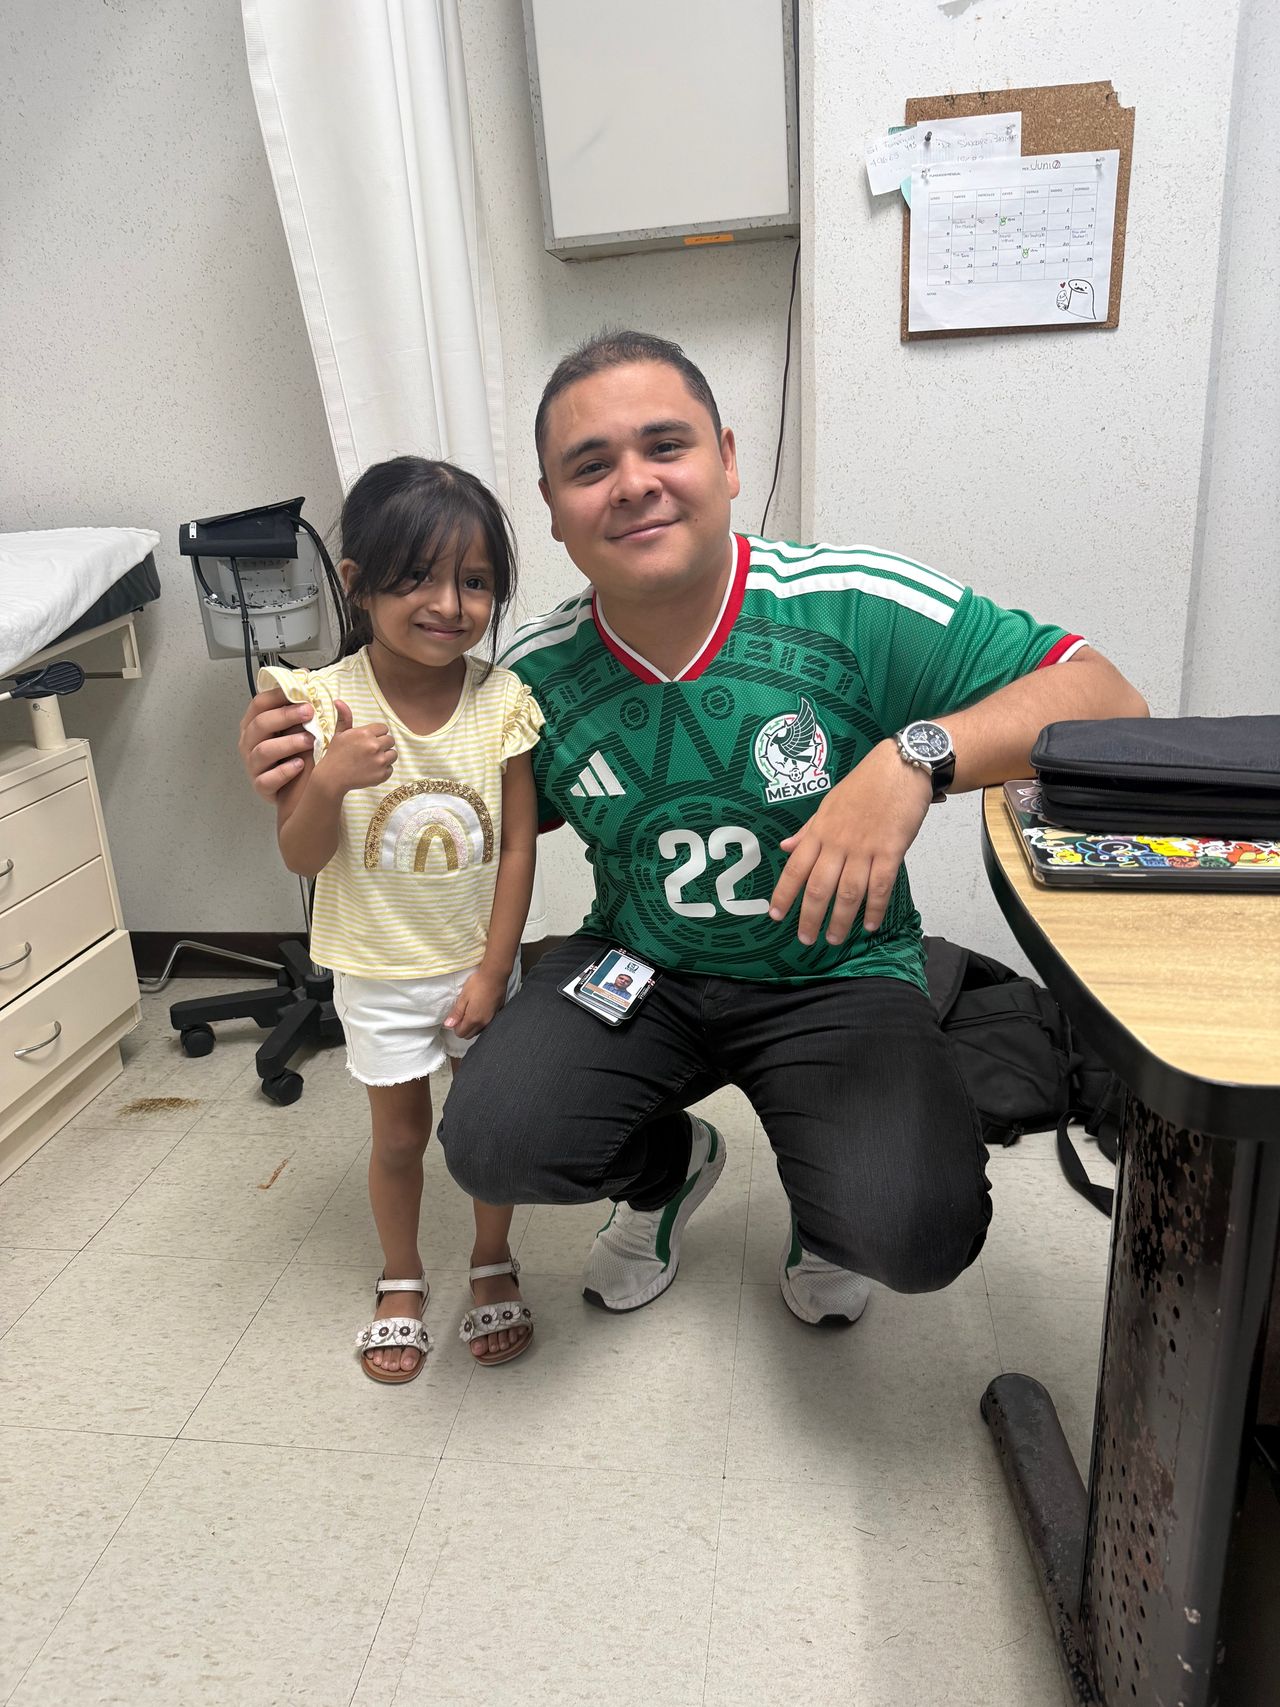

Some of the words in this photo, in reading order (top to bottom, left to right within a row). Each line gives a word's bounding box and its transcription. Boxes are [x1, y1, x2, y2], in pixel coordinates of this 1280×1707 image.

[1030, 159, 1061, 171] Junio
[767, 777, 829, 800] MÉXICO
[658, 825, 770, 918] 22
